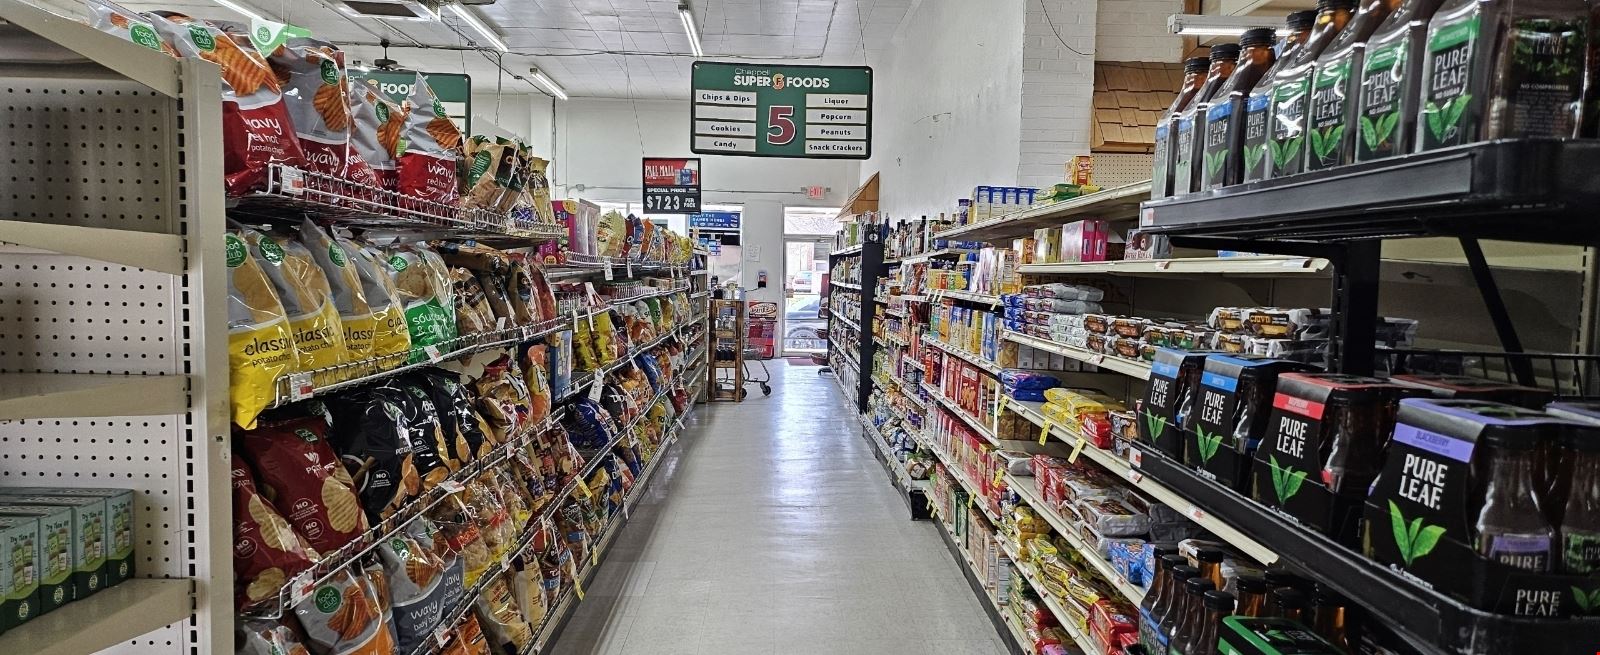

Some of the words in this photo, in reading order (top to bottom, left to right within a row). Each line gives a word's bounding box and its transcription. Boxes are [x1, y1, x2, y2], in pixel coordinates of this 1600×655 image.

[196, 36, 212, 46] club
[1434, 46, 1468, 73] PURE
[733, 75, 771, 87] SUPER
[786, 76, 830, 88] FOODS
[1433, 65, 1466, 91] LEAF
[702, 93, 723, 102] Chips
[733, 95, 750, 103] Dips
[824, 97, 849, 105] Liquor
[1317, 87, 1344, 105] PURE
[1367, 85, 1396, 107] LEAF
[820, 113, 852, 121] Popcorn
[1247, 112, 1265, 126] PURE
[710, 124, 741, 132] Cookies
[766, 105, 796, 145] 5
[820, 128, 851, 136] Peanuts
[1210, 119, 1228, 134] PURE
[1247, 125, 1264, 140] LEAF
[713, 140, 737, 149] Candy
[1209, 133, 1226, 147] LEAF
[809, 144, 830, 152] Snack
[832, 144, 863, 153] Crackers
[306, 151, 340, 172] wavy
[427, 162, 455, 183] wavy
[645, 165, 659, 177] PALL
[659, 165, 675, 177] MALL
[427, 178, 438, 186] red
[809, 186, 823, 197] EXIT
[252, 356, 277, 367] potato
[1153, 378, 1170, 395] PURE
[1204, 390, 1226, 410] PURE
[1279, 416, 1308, 441] PURE
[1415, 430, 1450, 447] BLACKBERRY
[1402, 453, 1448, 487] PURE
[295, 500, 309, 510] NO
[305, 521, 318, 531] NO
[235, 539, 249, 551] NO
[317, 589, 335, 605] food
[322, 596, 339, 609] club
[1516, 589, 1561, 603] PURE
[410, 600, 439, 620] wavy
